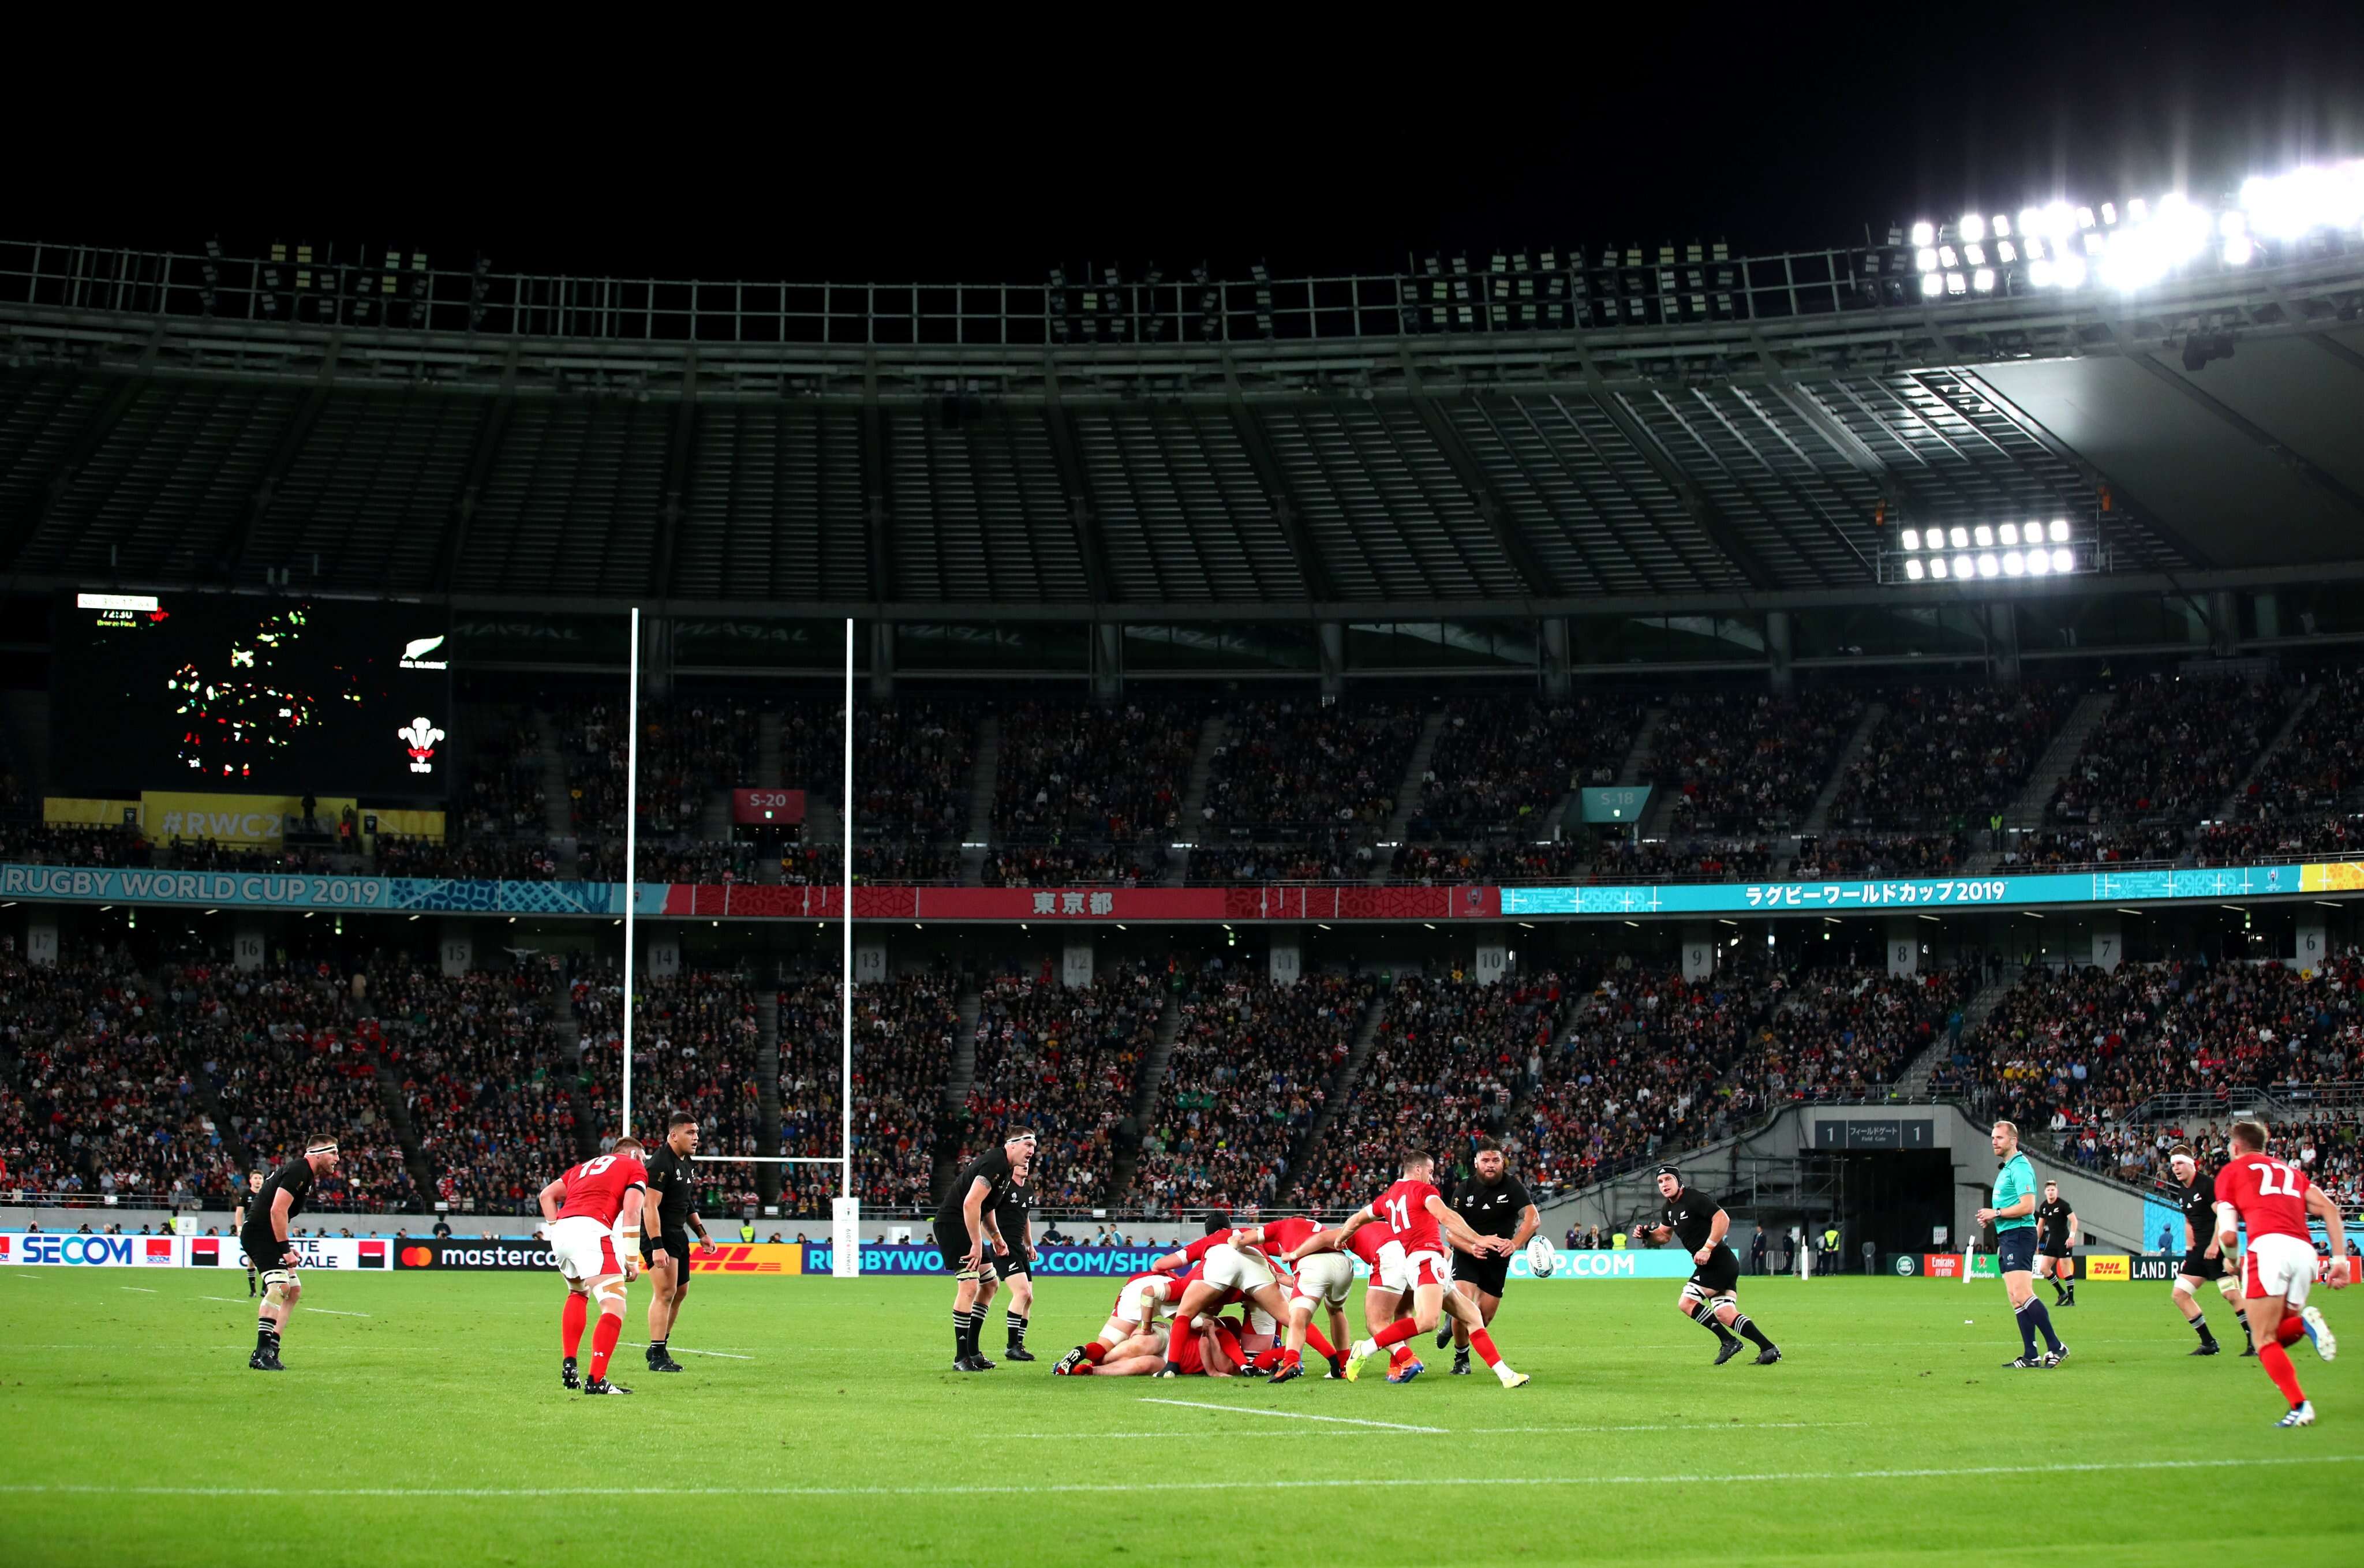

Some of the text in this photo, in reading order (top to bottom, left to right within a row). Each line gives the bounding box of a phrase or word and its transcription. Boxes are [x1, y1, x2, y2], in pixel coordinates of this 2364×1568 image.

[750, 794, 786, 807] S-20
[1601, 792, 1634, 805] S-18
[162, 812, 281, 837] #RWC2
[6, 868, 379, 904] RUGBY WORLD CUP 2019
[1745, 882, 2006, 907] ラグビーワールドカップ2019
[1033, 892, 1113, 916] 東京都
[240, 940, 258, 956] 16
[2101, 940, 2112, 957] 7
[2305, 933, 2316, 950] 6
[447, 945, 465, 961] 15
[655, 949, 673, 966] 14
[862, 952, 880, 968] 13
[1069, 953, 1087, 970] 12
[1480, 952, 1501, 969] 10
[1692, 949, 1702, 966] 9
[1897, 946, 1907, 962] 8
[1275, 954, 1292, 970] 11
[1827, 1127, 1834, 1142] 1
[1850, 1127, 1898, 1136] フィールドゲート
[1913, 1126, 1920, 1142] 1
[579, 1155, 618, 1179] 19
[2248, 1162, 2301, 1199] 22
[1385, 1194, 1412, 1234] 21
[23, 1236, 132, 1265] SECOM
[442, 1247, 559, 1266] masterca
[1932, 1256, 1955, 1268] Emirates
[2094, 1263, 2122, 1274] DHL
[2133, 1262, 2165, 1279] LAND
